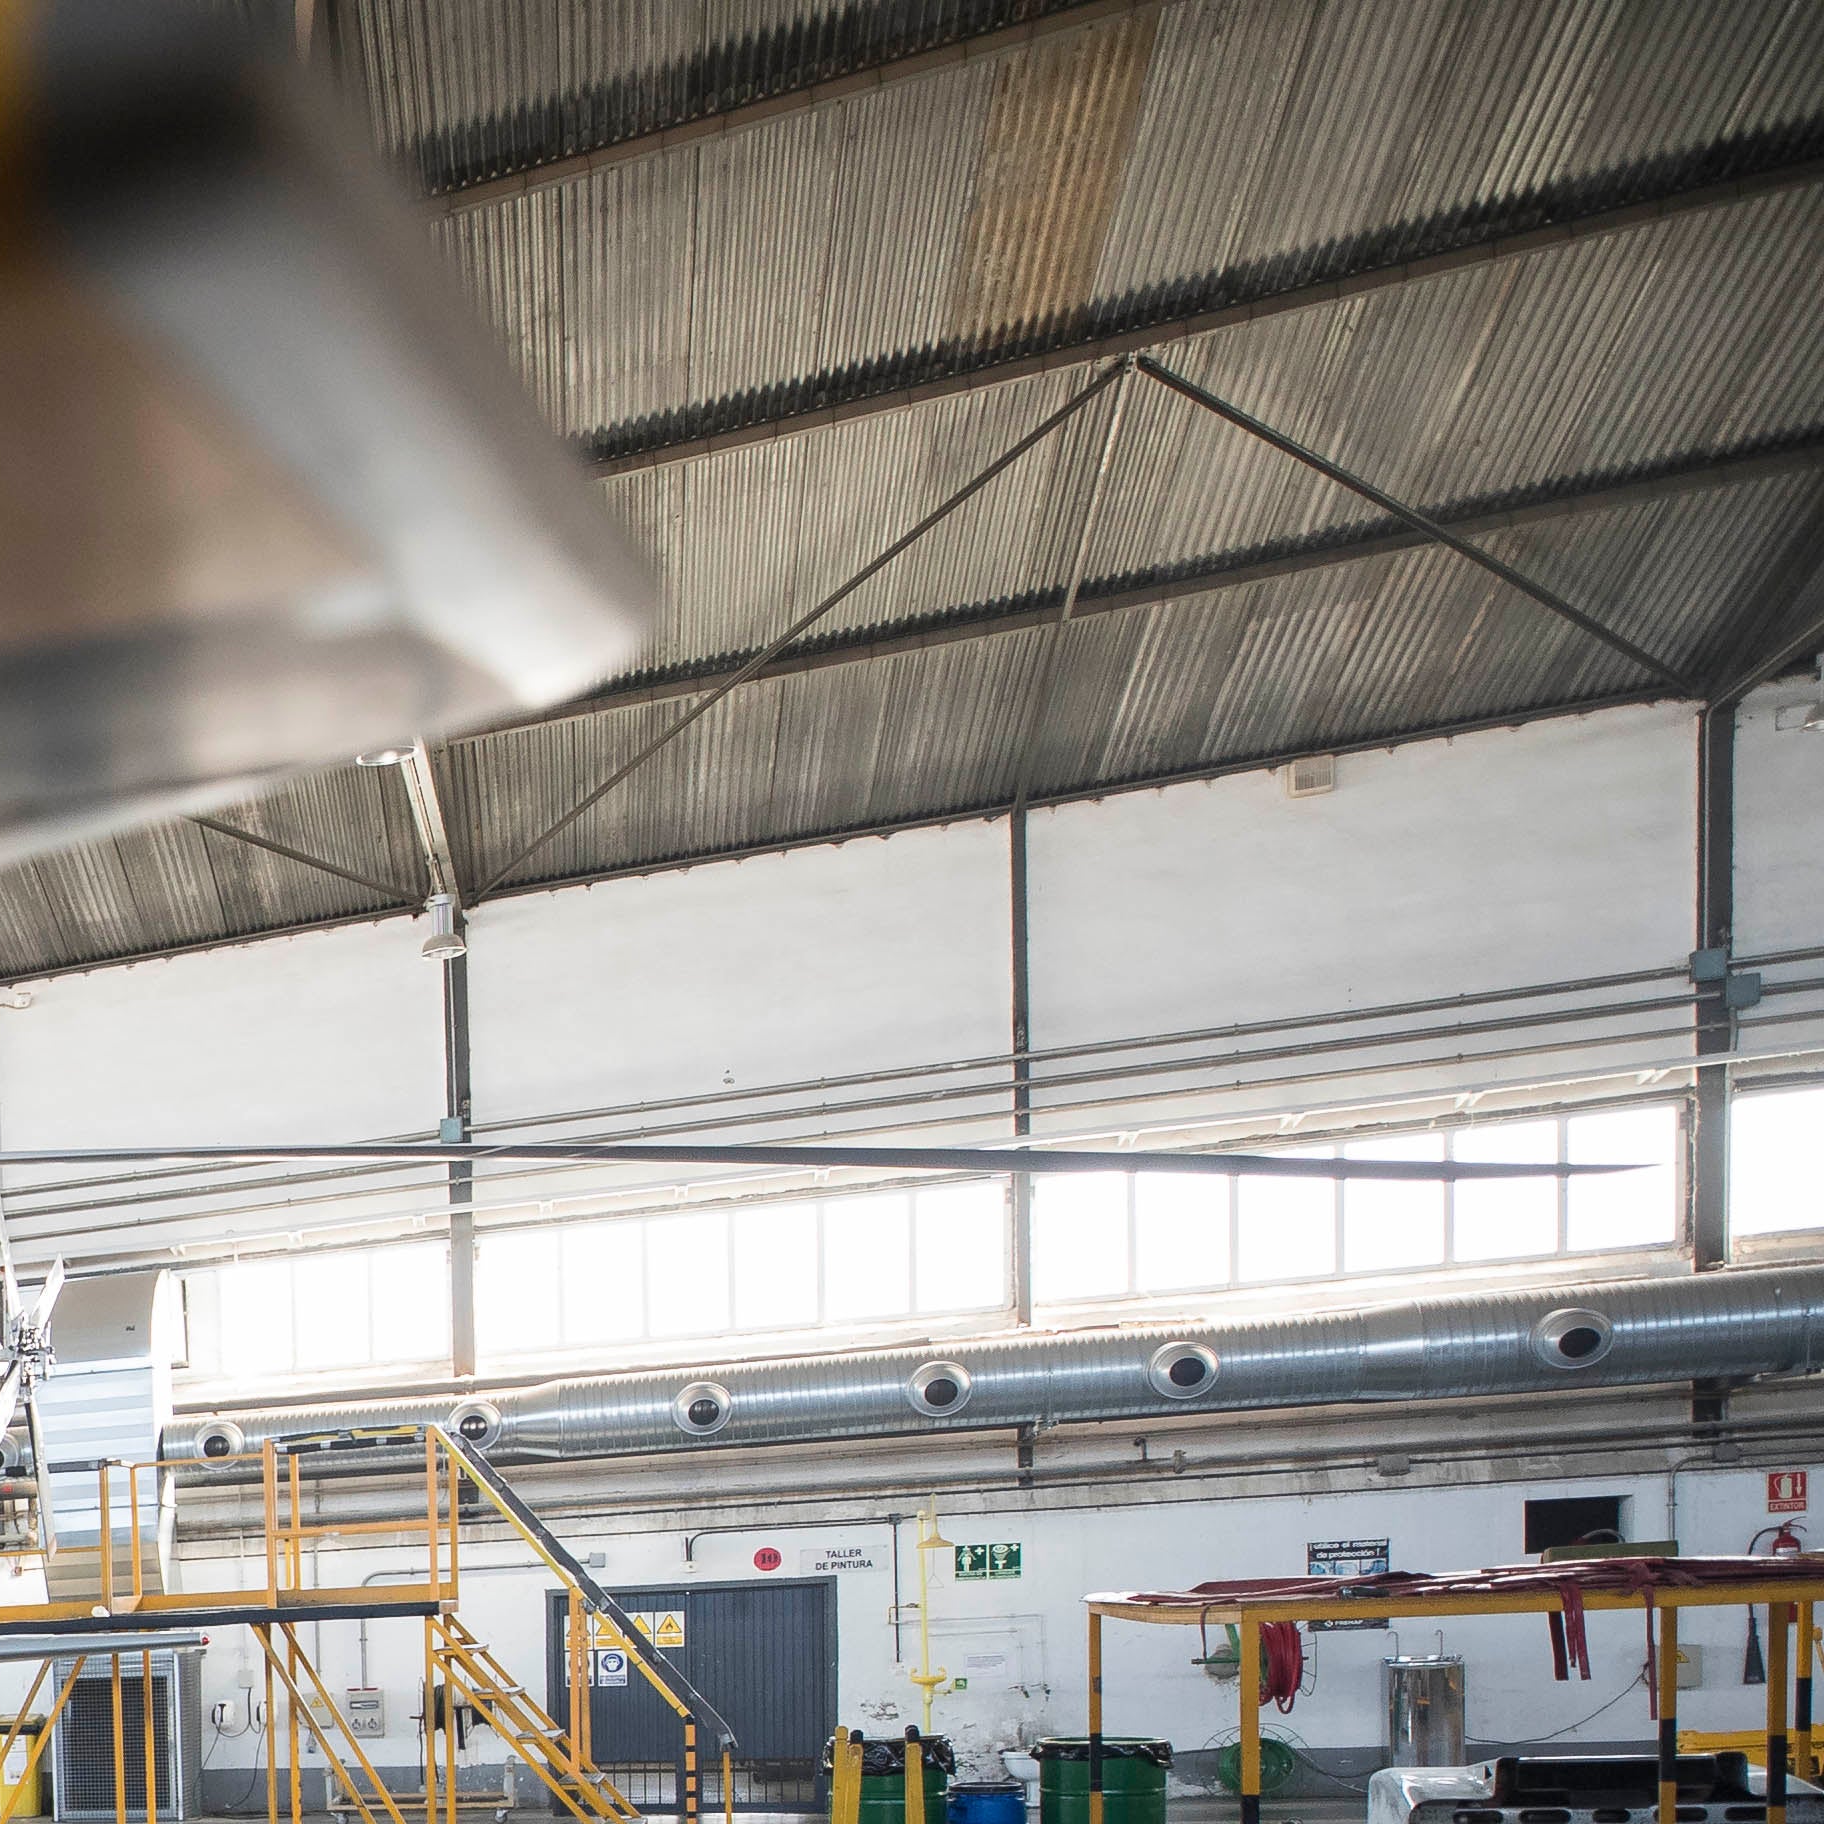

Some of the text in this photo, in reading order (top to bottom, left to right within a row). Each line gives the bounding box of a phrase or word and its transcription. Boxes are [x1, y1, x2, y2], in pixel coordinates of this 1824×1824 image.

[1769, 1501, 1805, 1511] EXTINTOR
[825, 1548, 862, 1559] TALLER
[815, 1559, 873, 1571] DE PINTURA
